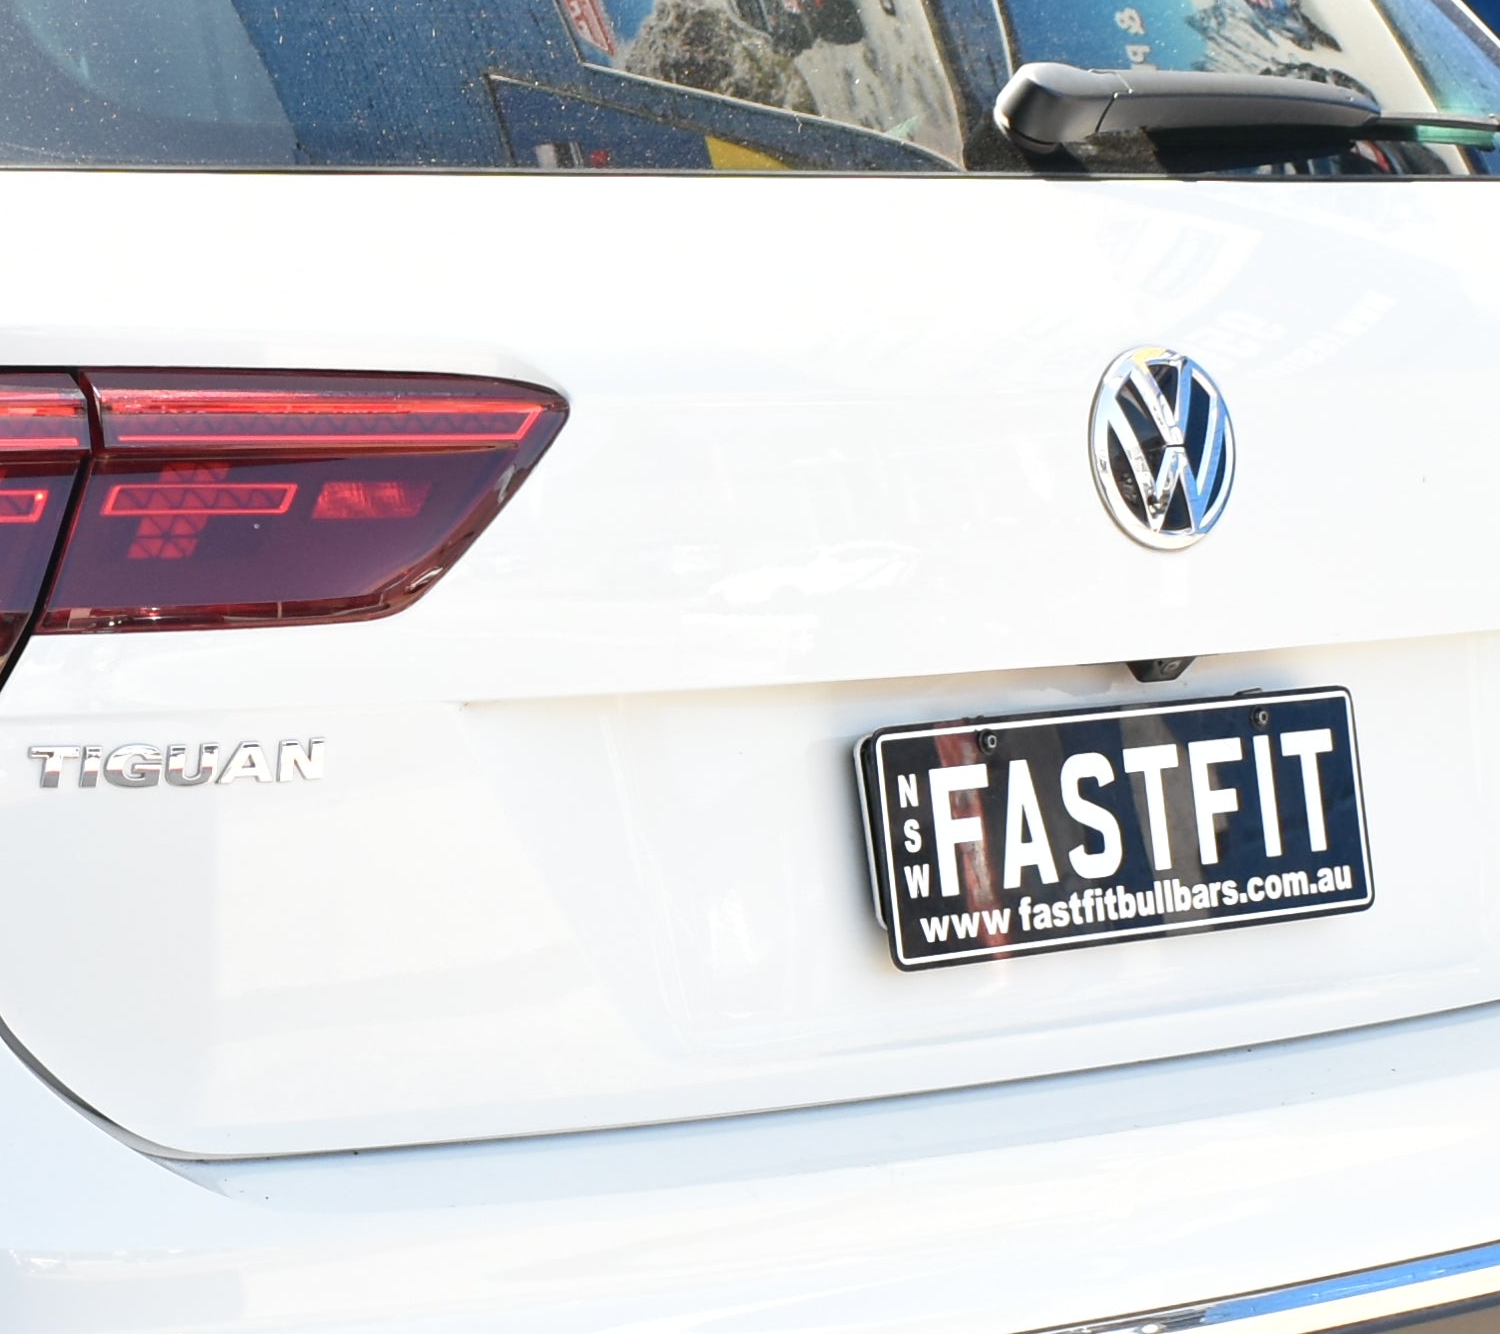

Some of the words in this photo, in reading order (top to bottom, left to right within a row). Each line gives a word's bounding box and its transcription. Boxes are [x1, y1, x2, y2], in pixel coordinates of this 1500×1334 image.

[28, 737, 326, 788] TIGUAN
[928, 728, 1333, 898] FASTFIT
[1018, 863, 1353, 932] fastfitbullbars.com.au
